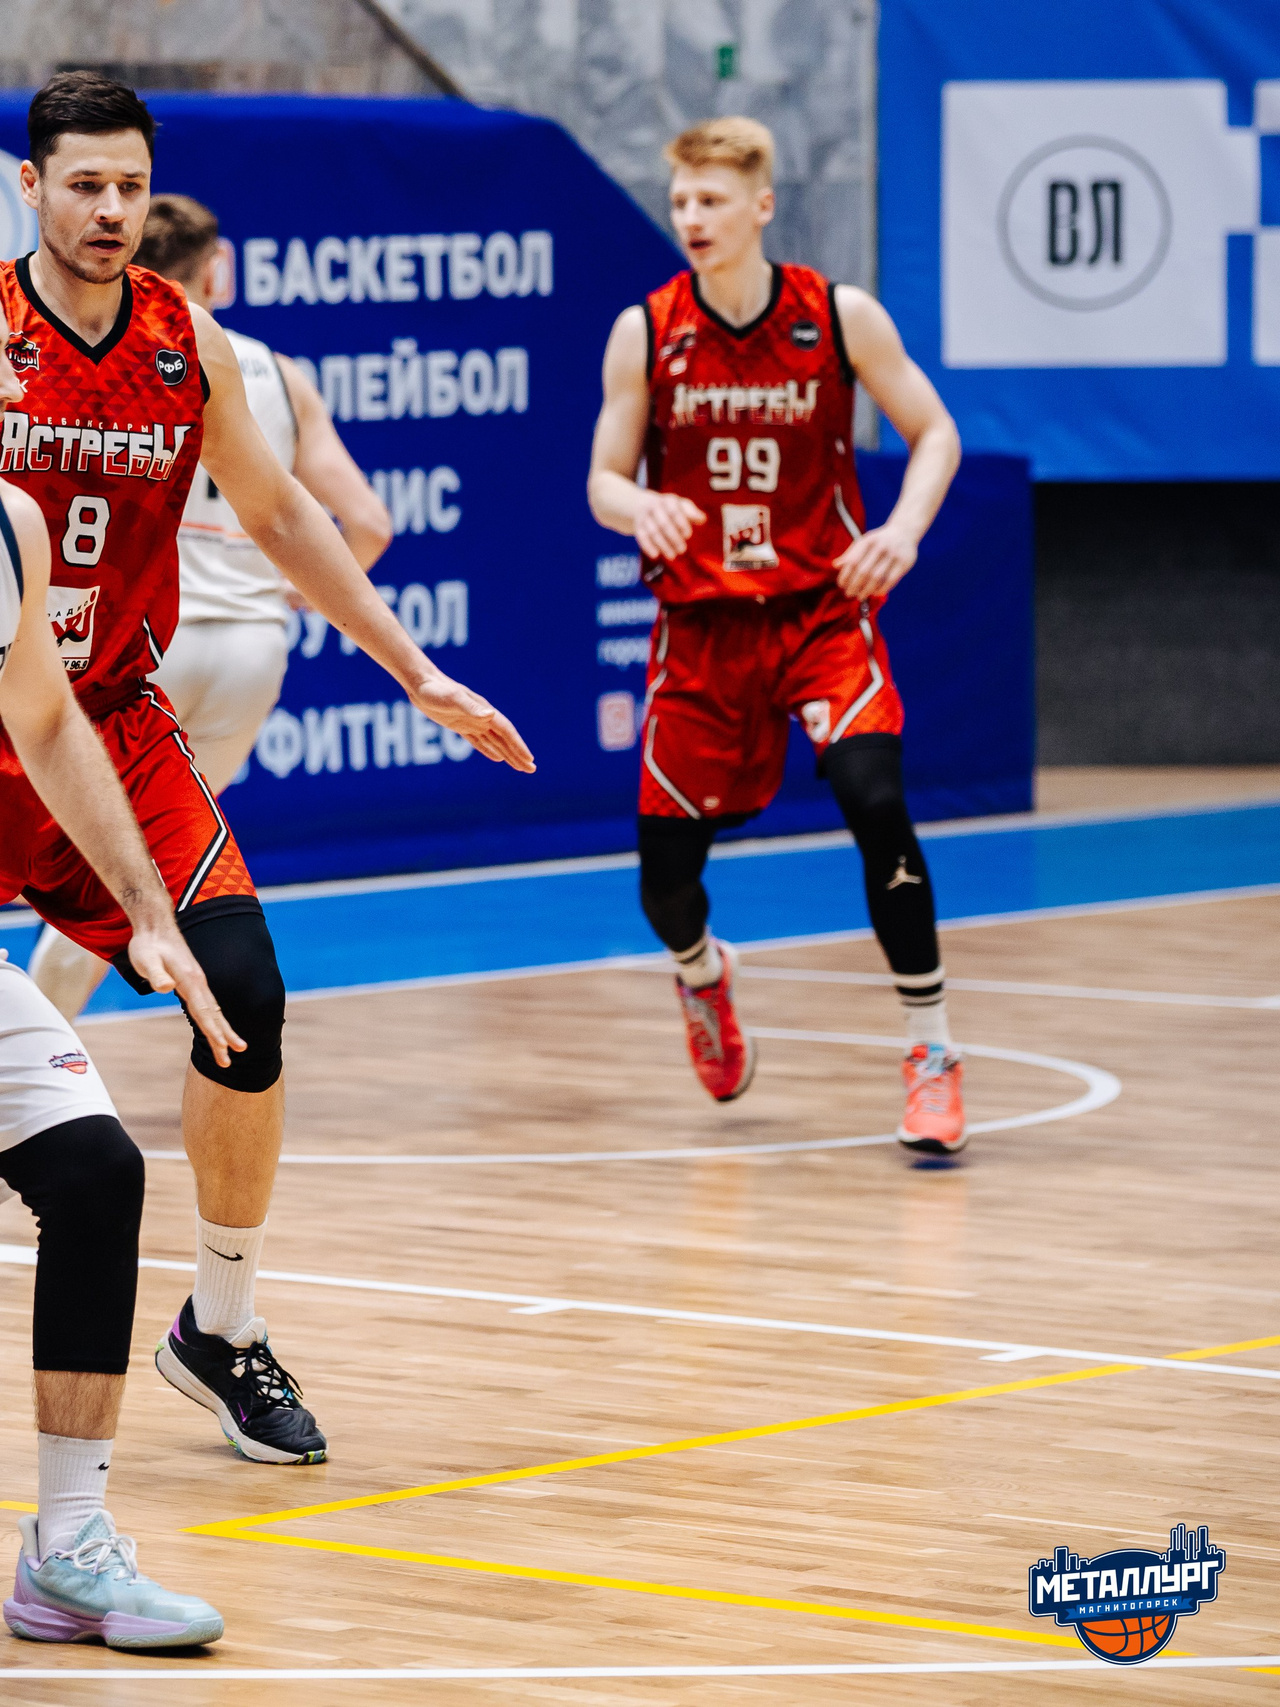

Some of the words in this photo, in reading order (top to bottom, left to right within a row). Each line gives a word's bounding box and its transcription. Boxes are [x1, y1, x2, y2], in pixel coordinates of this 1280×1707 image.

[243, 230, 554, 306] БАСКЕТБОЛ
[159, 358, 183, 374] РФБ
[292, 338, 529, 421] ЛЕЙБОЛ
[33, 416, 149, 433] ЧЕБОКСАРЫ
[706, 436, 781, 493] 99
[60, 494, 111, 568] 8
